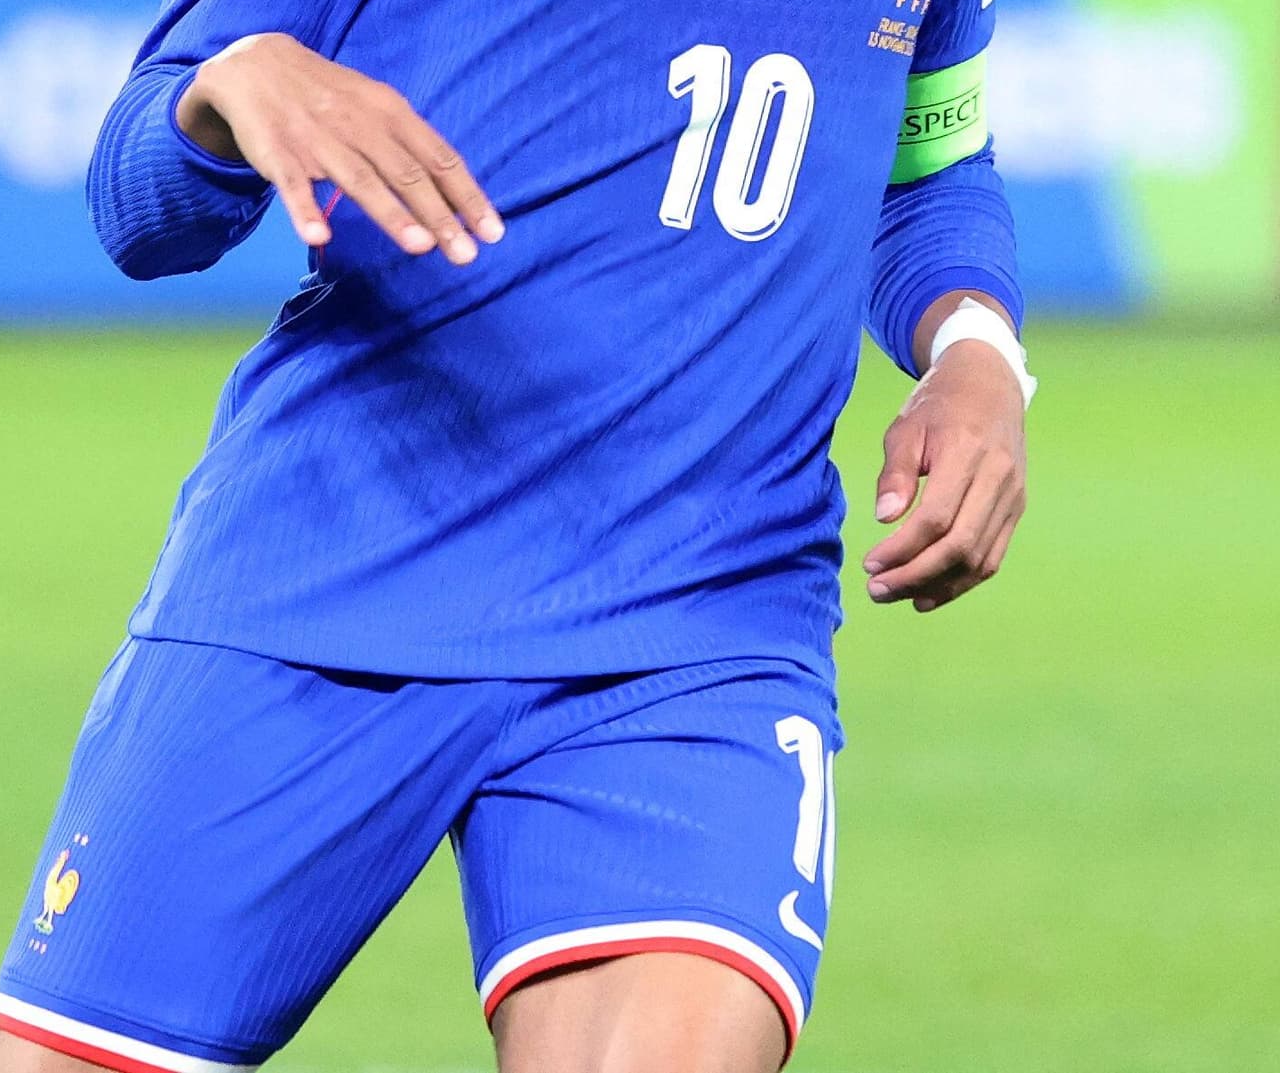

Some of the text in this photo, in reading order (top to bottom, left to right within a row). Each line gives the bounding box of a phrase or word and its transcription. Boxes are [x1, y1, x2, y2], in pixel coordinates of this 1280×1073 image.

[658, 43, 815, 242] 10
[898, 92, 980, 137] SPECT
[775, 715, 837, 910] 1
